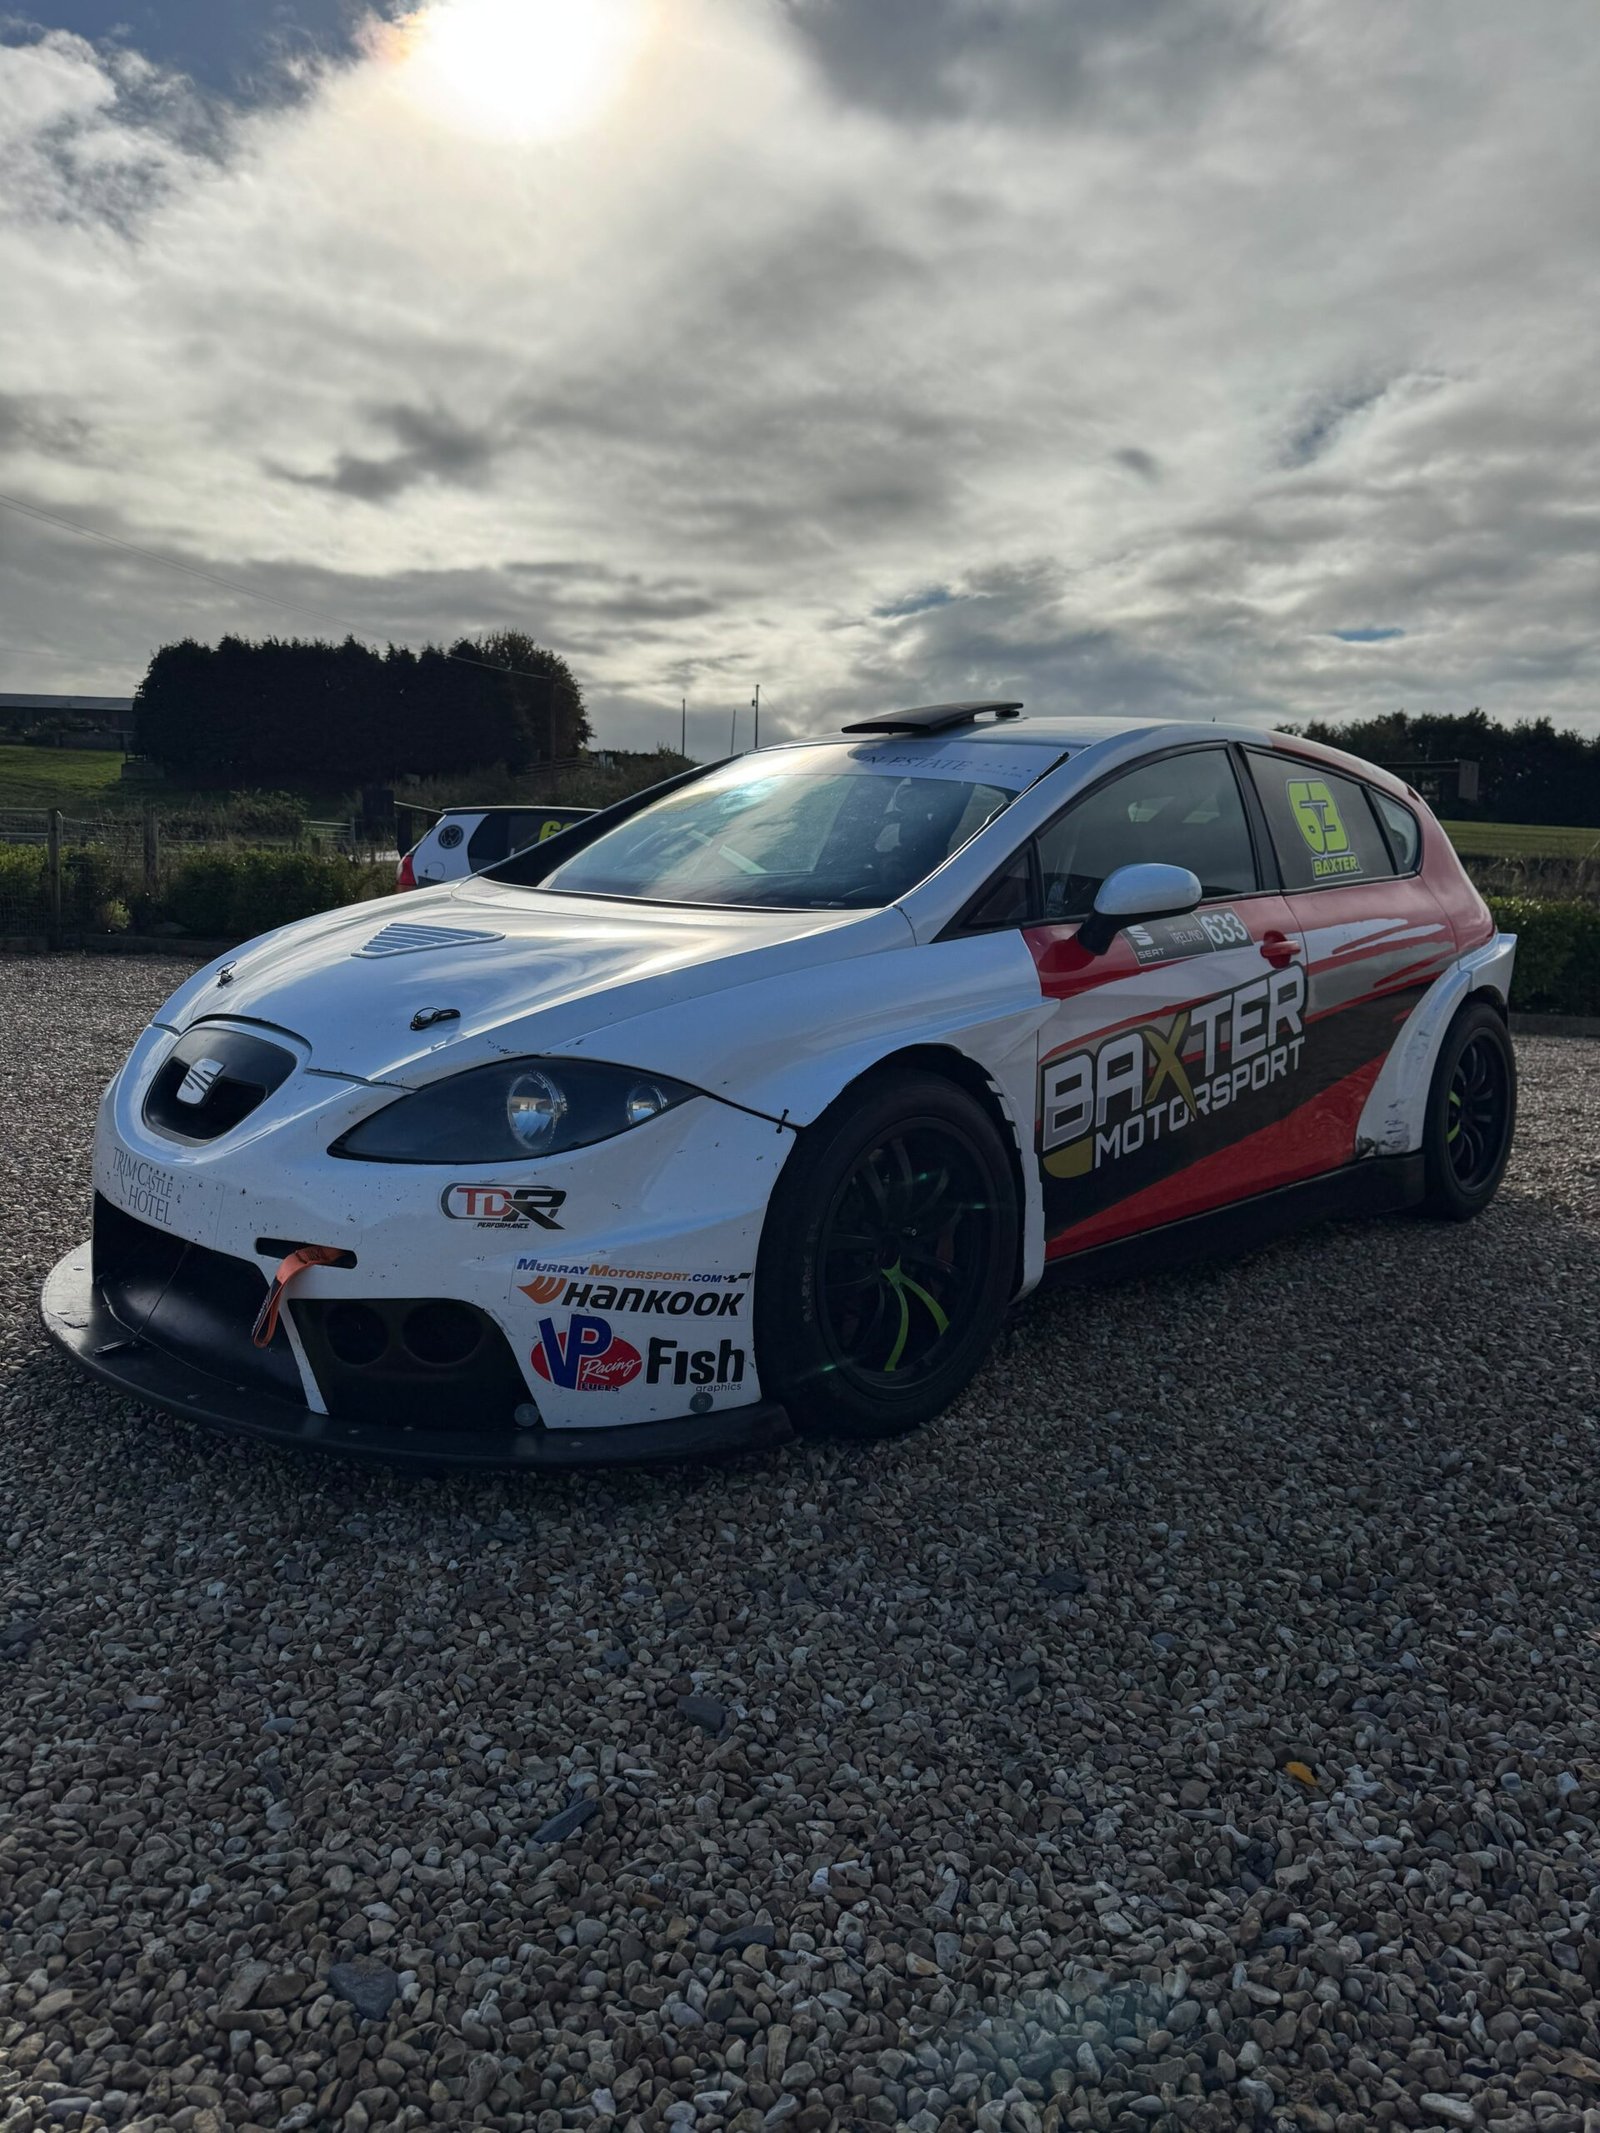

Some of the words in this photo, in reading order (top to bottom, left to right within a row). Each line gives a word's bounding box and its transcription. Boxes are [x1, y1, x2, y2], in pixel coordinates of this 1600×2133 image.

[1313, 856, 1358, 876] BAXTER
[1201, 912, 1248, 944] 633
[1138, 947, 1165, 959] SEAT
[1042, 966, 1304, 1151] BAXTER
[1095, 1036, 1305, 1168] MOTORSPORT
[128, 1184, 172, 1226] HOTEL
[456, 1187, 567, 1230] TDR
[538, 1314, 613, 1390] VP
[582, 1356, 642, 1381] Racing
[646, 1337, 745, 1385] Fish
[581, 1382, 620, 1392] FUELS
[695, 1382, 742, 1393] graphics
